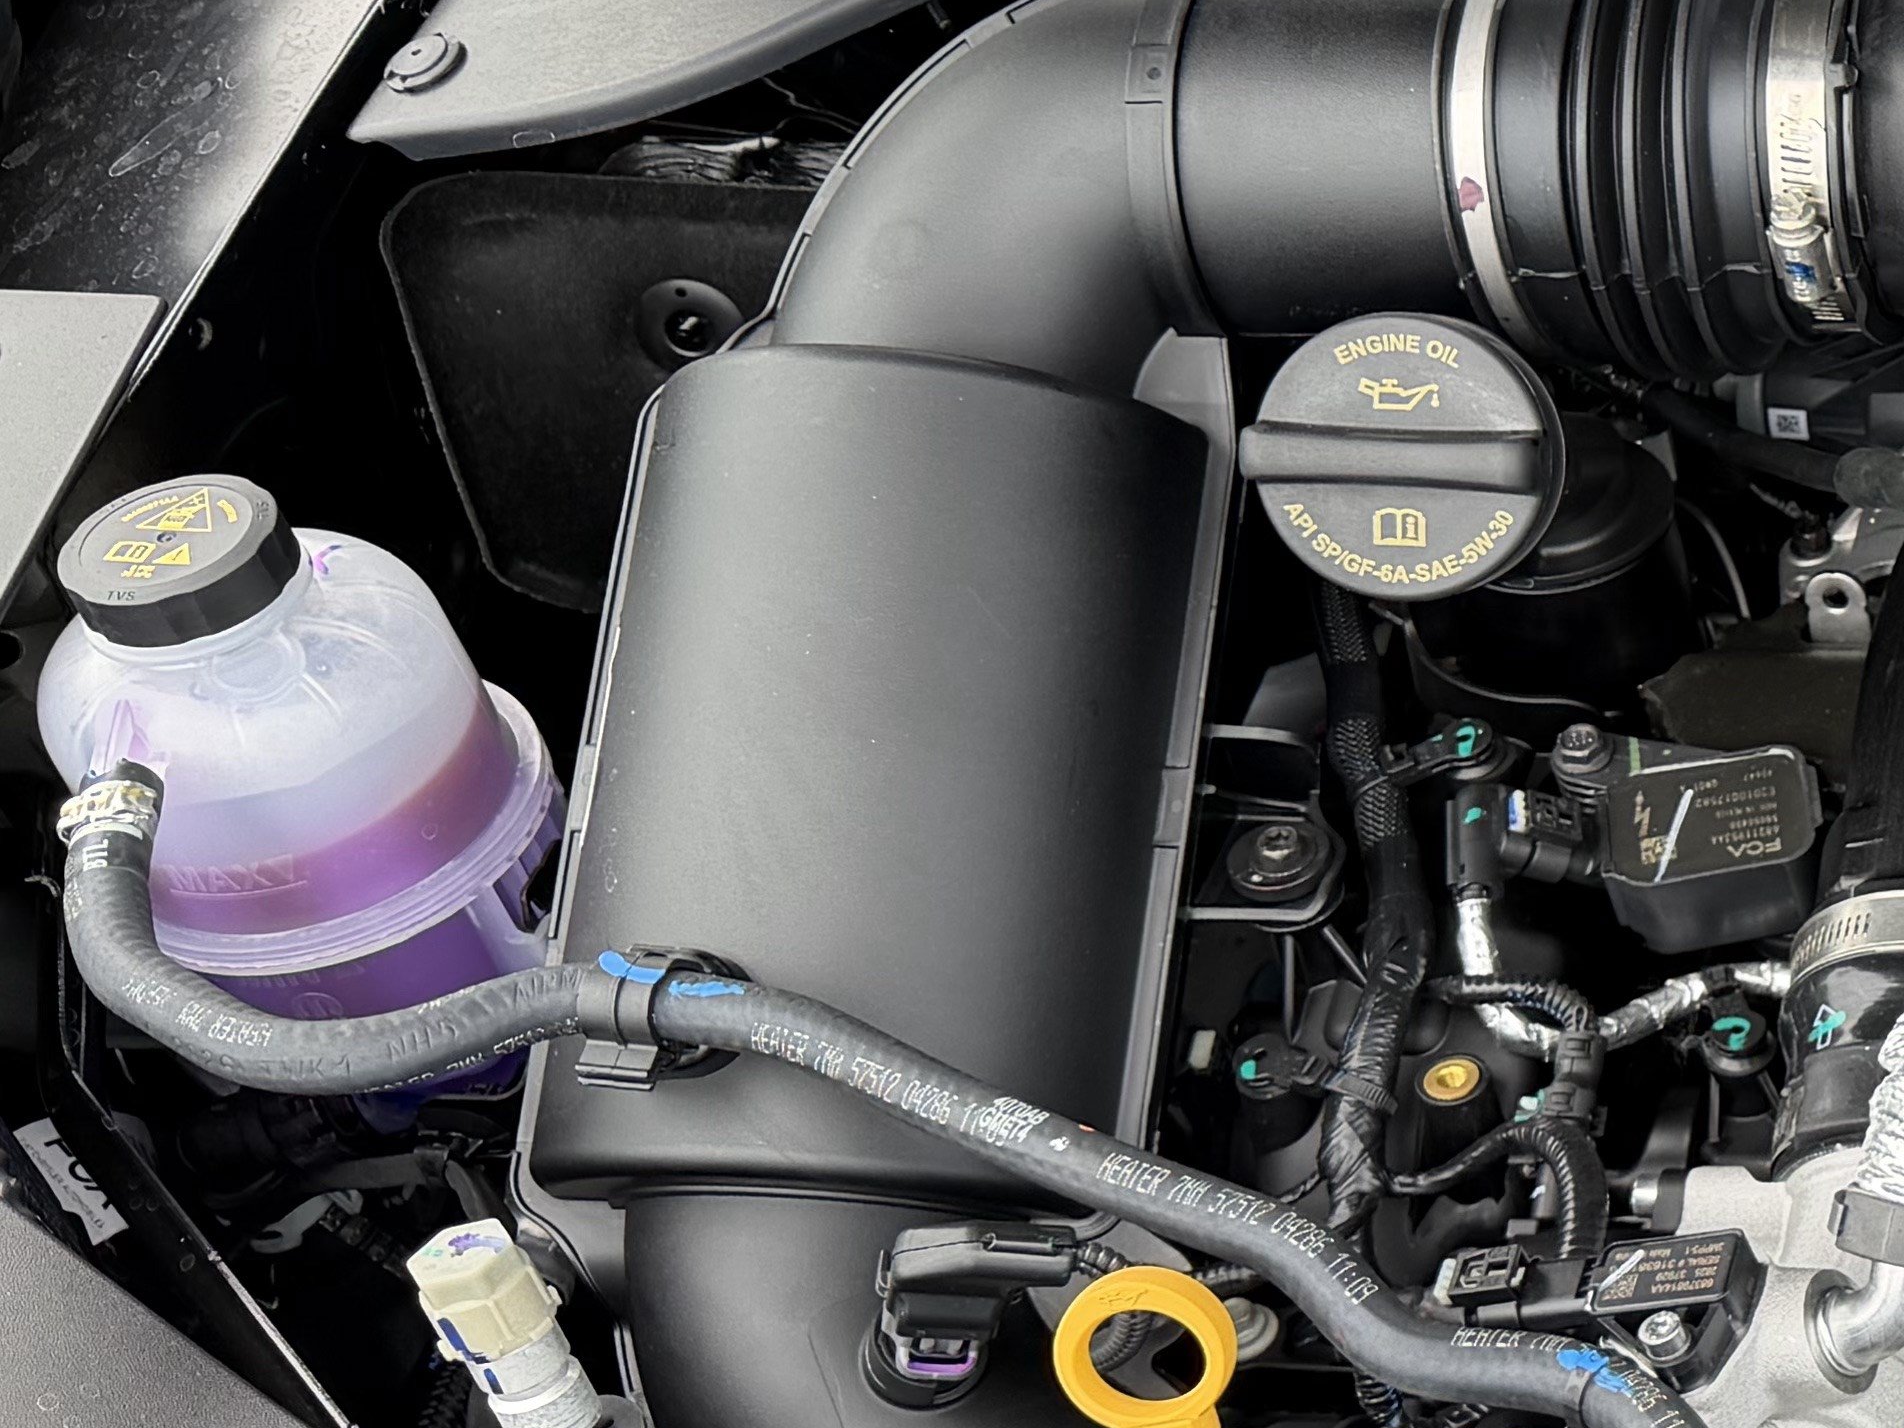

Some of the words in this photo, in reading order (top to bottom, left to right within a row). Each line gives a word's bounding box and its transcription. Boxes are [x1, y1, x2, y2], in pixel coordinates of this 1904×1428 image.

[1333, 333, 1421, 366] ENGINE
[1425, 339, 1460, 369] OIL
[1283, 503, 1320, 539] API
[1726, 837, 1782, 858] FCA
[168, 863, 273, 894] MAX
[751, 1022, 810, 1067] HEATER
[848, 1056, 903, 1103] 57512
[900, 1079, 960, 1127] 04286
[1095, 1152, 1172, 1196] HEATER
[1166, 1174, 1213, 1208] 7MM
[1206, 1187, 1277, 1226] 57512
[1270, 1205, 1336, 1260] 04286
[1323, 1251, 1380, 1306] 11:09
[1451, 1326, 1527, 1348] HEATER
